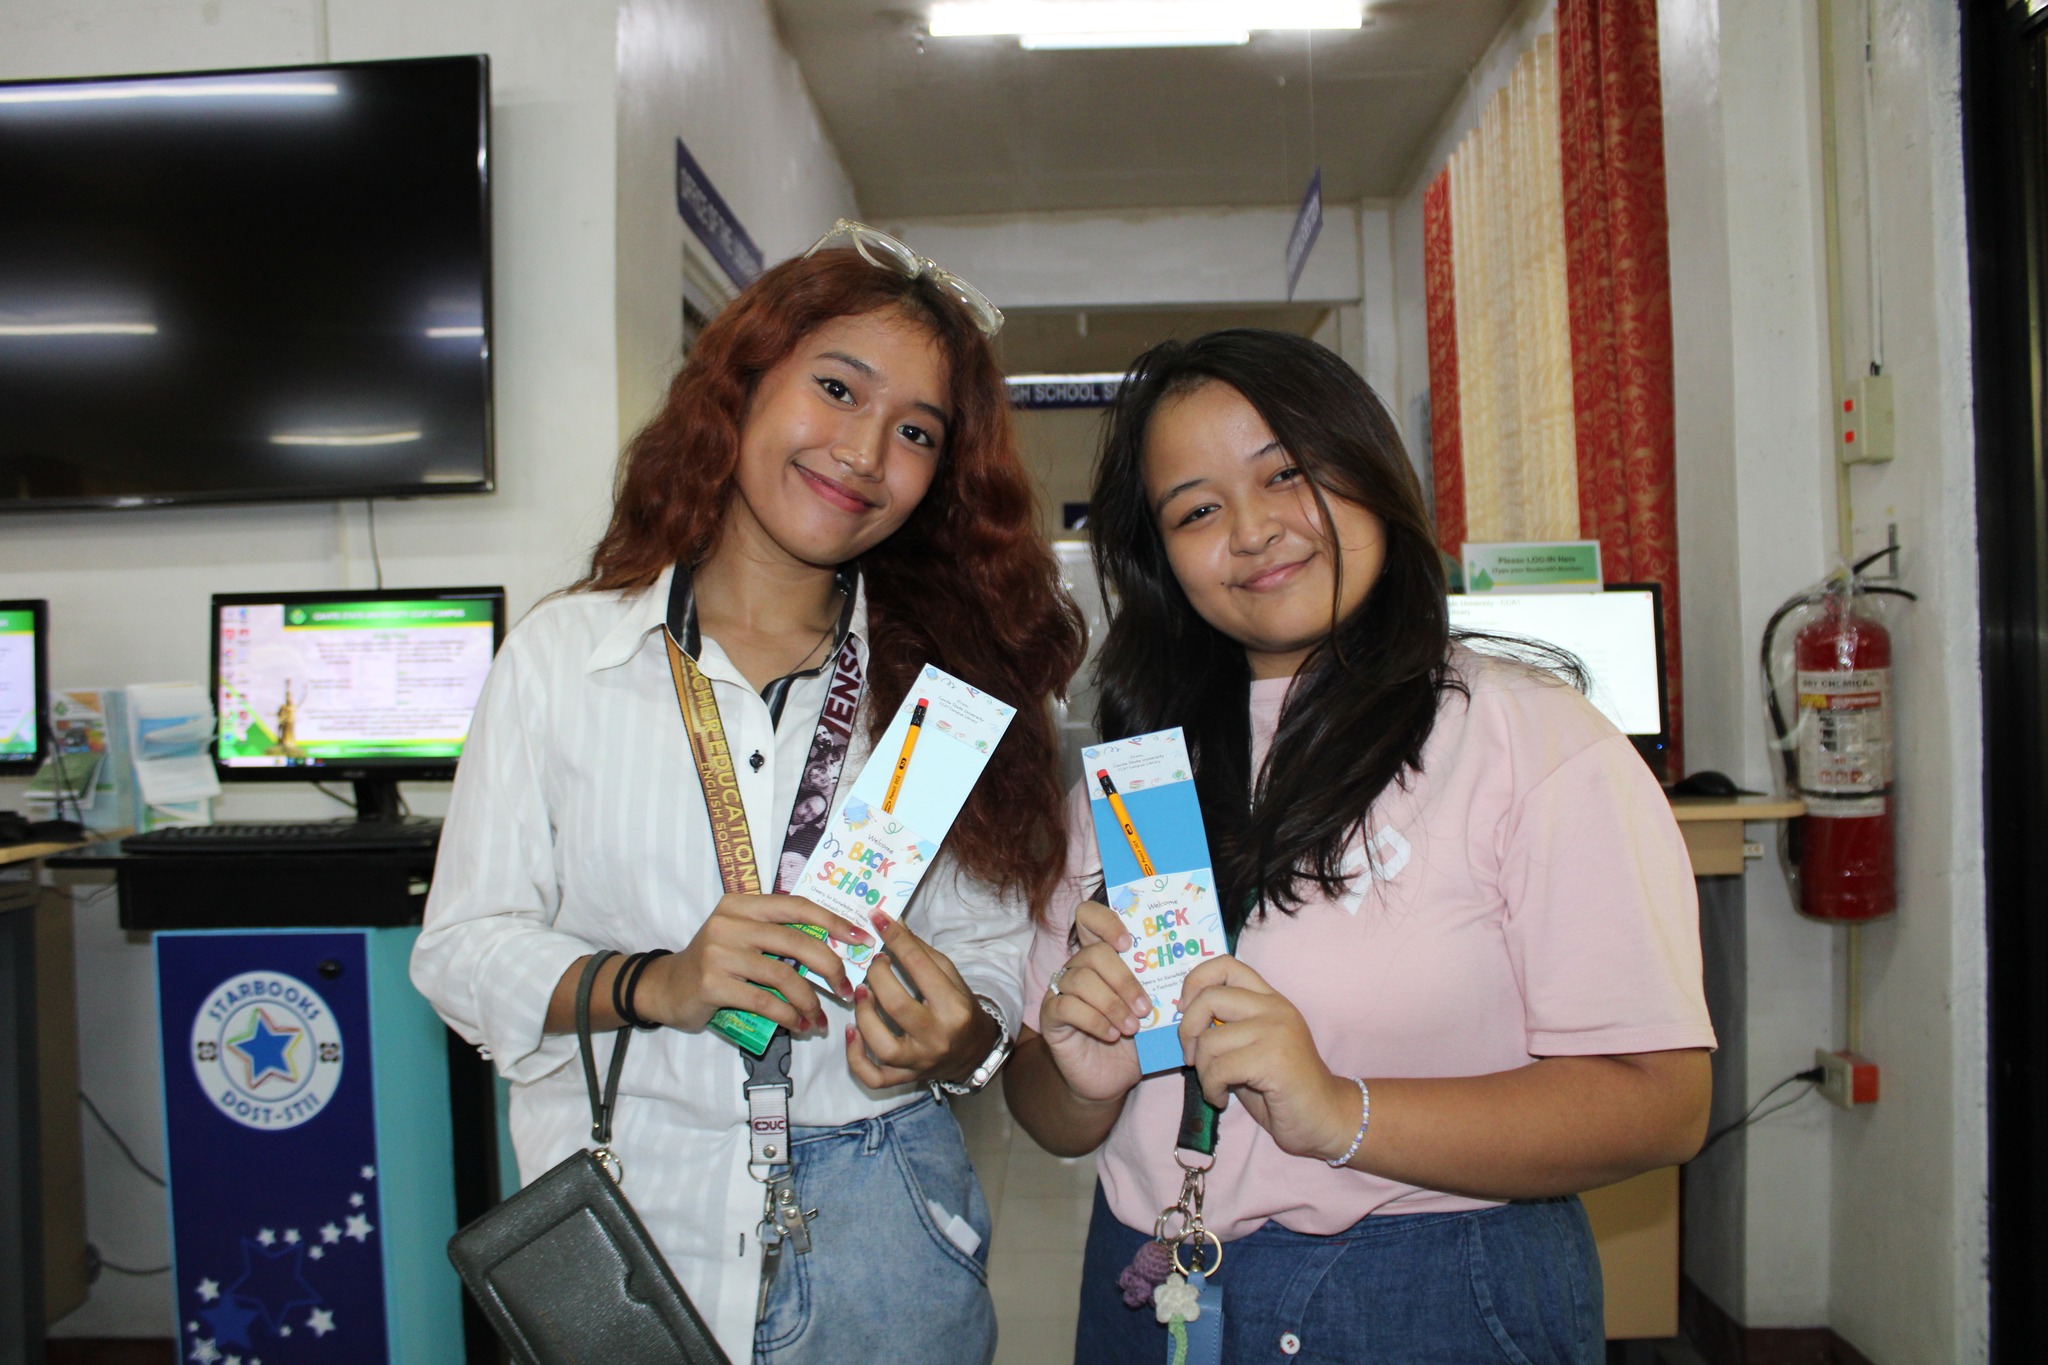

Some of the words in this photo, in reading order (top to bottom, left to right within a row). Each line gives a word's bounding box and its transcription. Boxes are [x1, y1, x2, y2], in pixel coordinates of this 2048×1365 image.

[1034, 383, 1100, 401] SCHOOL
[701, 762, 724, 818] ENGLISH
[708, 739, 757, 882] EDUCATION
[848, 841, 897, 878] BACK
[867, 833, 894, 855] Welcome
[816, 861, 888, 910] SCHOOL
[857, 866, 872, 881] TO
[1148, 899, 1179, 911] Welcome
[1142, 907, 1191, 938] BACK
[1162, 930, 1178, 943] TO
[1133, 938, 1215, 974] SCHOOL
[208, 980, 321, 1022] STARBOOKS
[220, 1090, 321, 1124] DOST-STII
